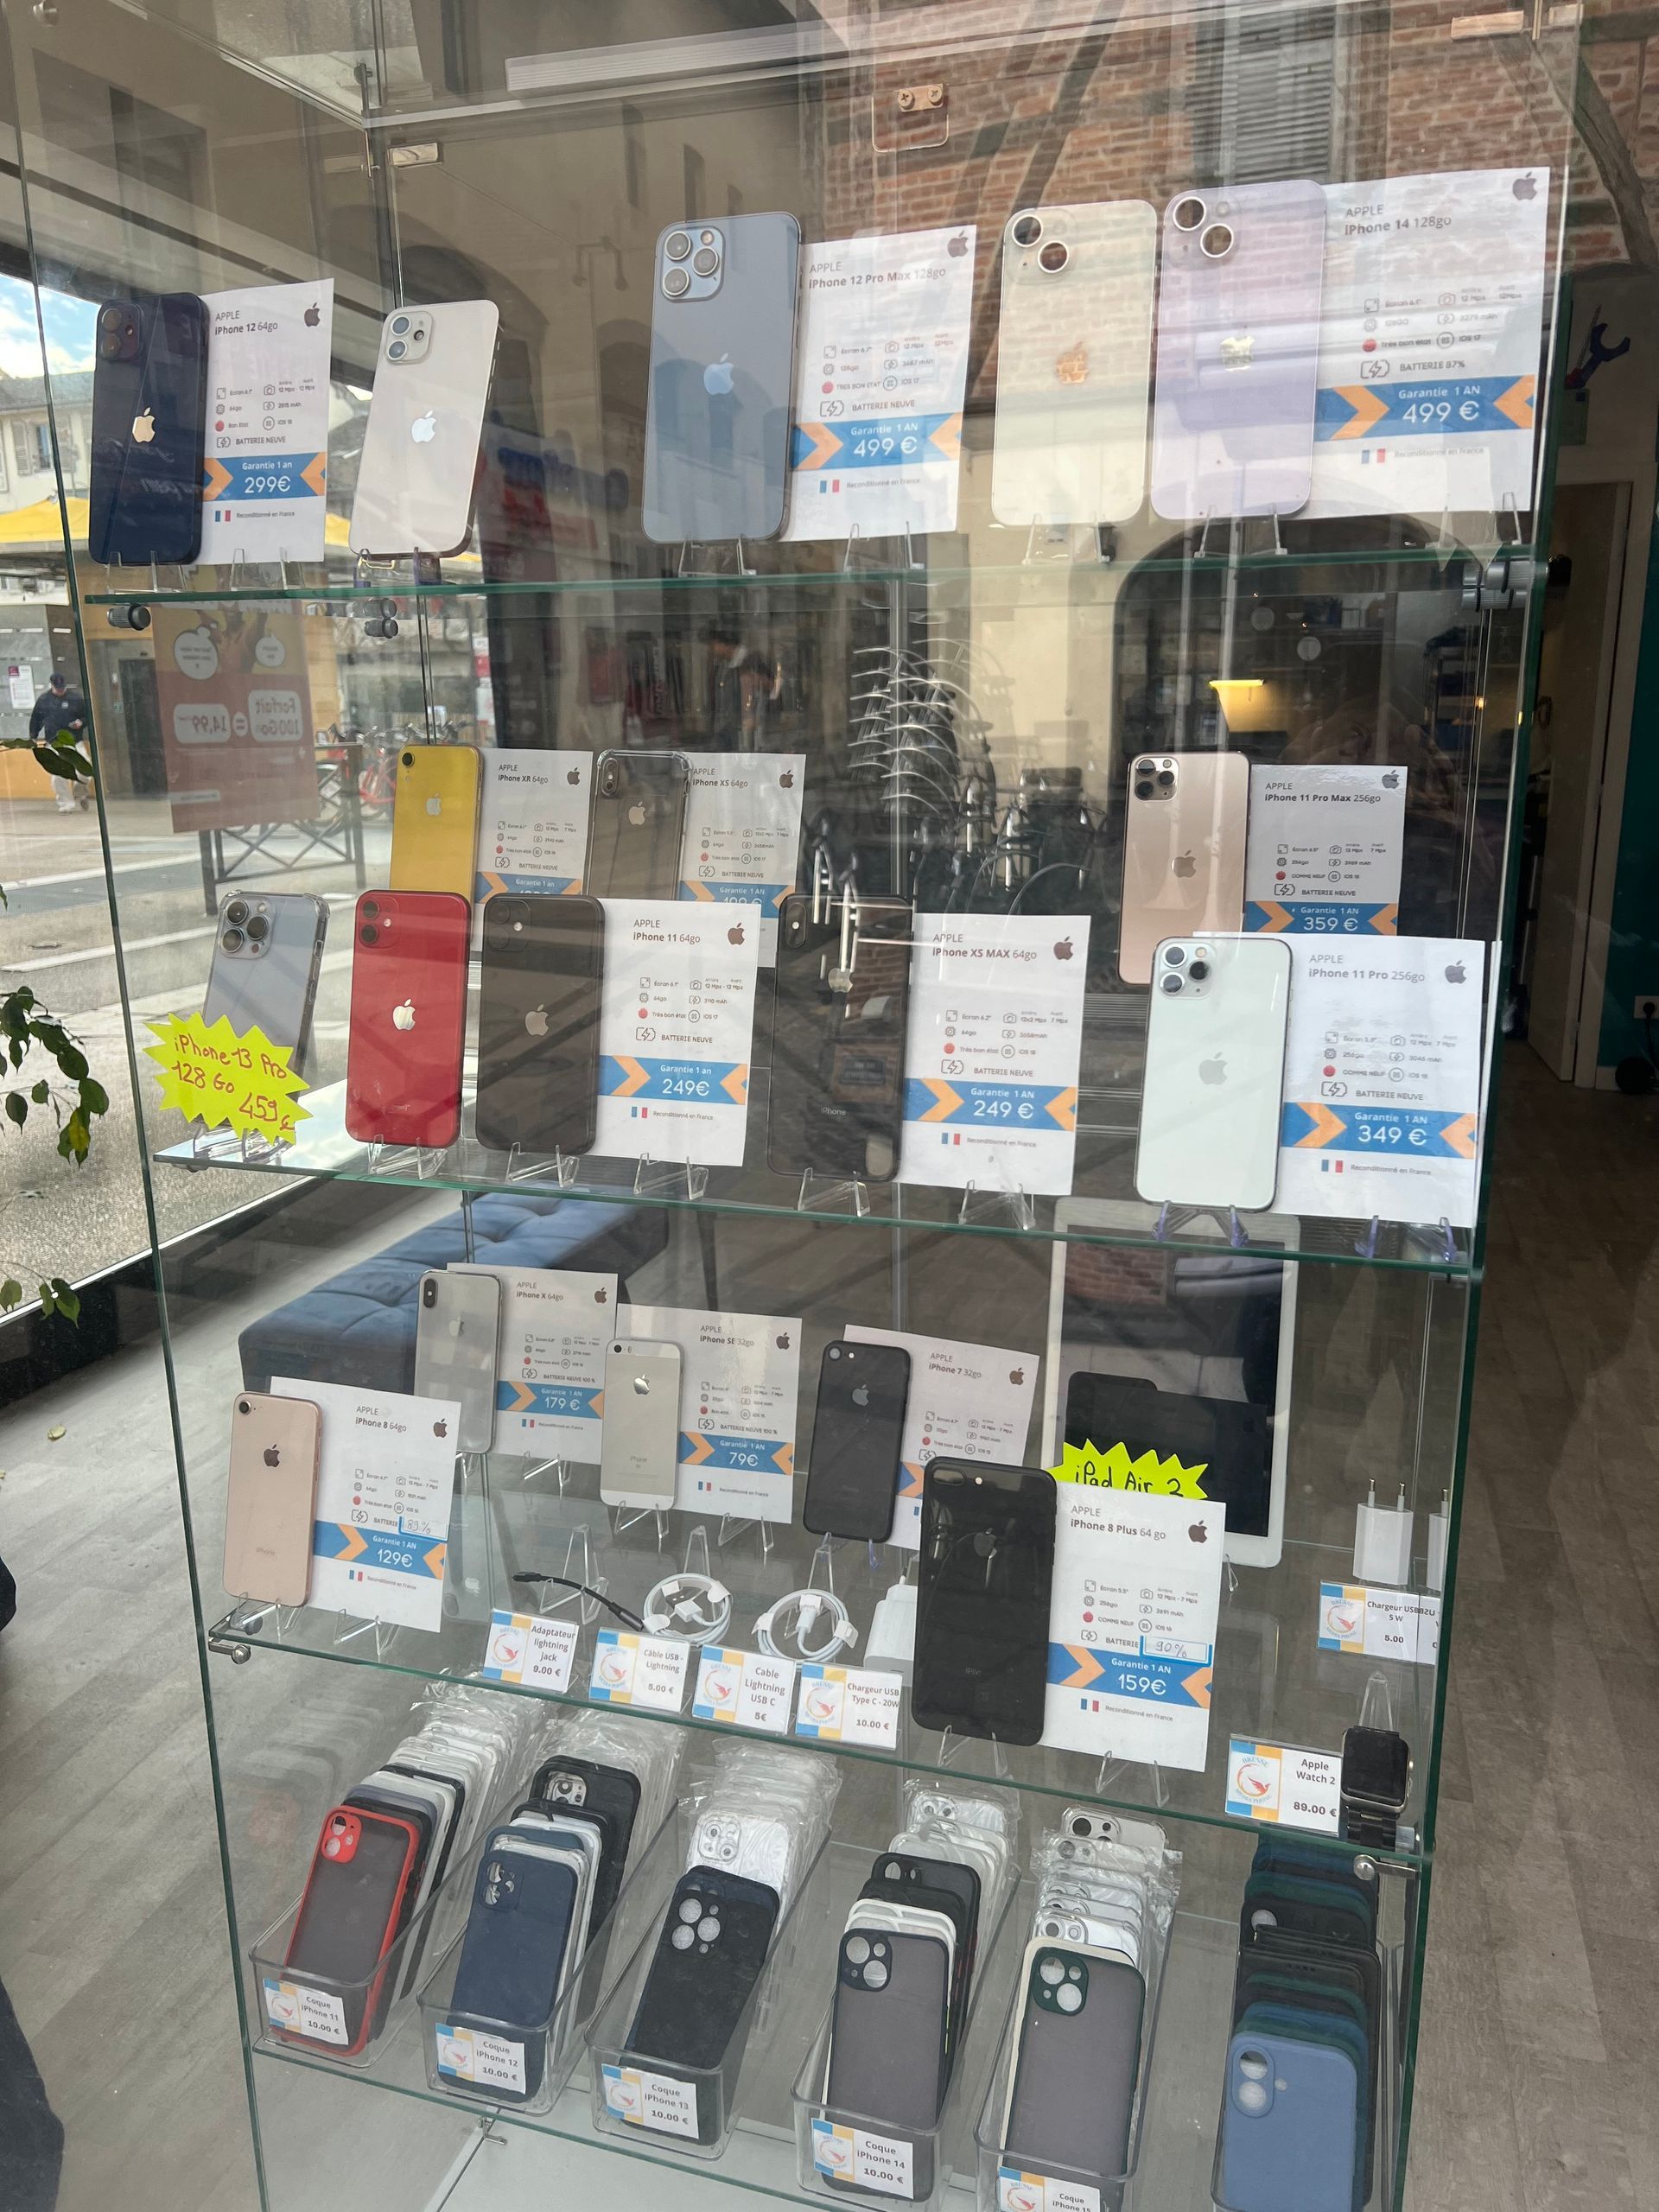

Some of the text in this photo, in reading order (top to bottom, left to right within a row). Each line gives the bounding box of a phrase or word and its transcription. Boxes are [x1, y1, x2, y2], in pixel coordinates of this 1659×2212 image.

[1345, 205, 1384, 216] APPLE
[1344, 215, 1452, 236] iPhone 14 128go
[809, 268, 945, 289] iPhone 12 Pro Max 128go
[215, 311, 240, 321] APPLE
[214, 321, 278, 335] iPhone 12 64go
[1400, 362, 1444, 372] BATTERIE
[1402, 401, 1479, 423] 499 €
[854, 435, 918, 457] 499 €
[245, 476, 291, 493] 299€
[532, 776, 548, 785] 64go
[730, 779, 748, 788] 64go
[633, 919, 660, 928] APPLE
[1303, 918, 1358, 931] 359 €
[633, 932, 664, 941] iPhone
[679, 934, 700, 944] 64go
[932, 949, 1037, 961] iPhone XS MAX 64go
[1309, 969, 1425, 982] iPhone 11 Pro 256go
[175, 1033, 287, 1078] iPhone 13 Pro
[660, 1065, 694, 1073] Garantie
[172, 1061, 234, 1093] 128 Go
[662, 1078, 709, 1096] 249€
[973, 1101, 1033, 1118] 249 €
[1358, 1125, 1427, 1146] 349 €
[737, 1338, 753, 1347] 32go
[929, 1363, 955, 1374] iPhone
[963, 1370, 981, 1379] 32go
[545, 1396, 580, 1410] 179 €
[356, 1417, 381, 1427] iPhone
[390, 1422, 407, 1432] 64go
[729, 1452, 758, 1466] 79€
[1076, 1460, 1184, 1497] iPad Air 2
[1071, 1505, 1101, 1517] APPLE
[374, 1517, 397, 1527] BATTERIE
[1071, 1519, 1166, 1540] iPhone 8 Plus 64 go
[378, 1549, 412, 1567] 129€
[1368, 1601, 1402, 1611] Chargeur
[531, 1625, 575, 1639] Adaptateur
[1105, 1637, 1140, 1649] BATTERIE
[1385, 1635, 1404, 1643] 5.00
[534, 1639, 569, 1653] lightning
[540, 1652, 556, 1662] jack
[644, 1649, 664, 1659] Câble
[665, 1652, 679, 1661] USB
[533, 1665, 553, 1675] 9.00
[646, 1661, 680, 1673] Lightning
[755, 1668, 779, 1679] Cable
[648, 1683, 666, 1693] 5.00
[745, 1680, 785, 1695] Lightning
[848, 1683, 899, 1696] Chargeur USB
[1118, 1674, 1166, 1695] 159€
[751, 1694, 767, 1704] USB
[852, 1694, 870, 1705] Type
[754, 1713, 766, 1721] 5€
[856, 1719, 880, 1728] 10.00
[1301, 1758, 1329, 1771] Apple
[1296, 1770, 1326, 1783] Watch
[1294, 1802, 1337, 1817] 89.00 €
[306, 1996, 331, 2009] Coque
[302, 2005, 328, 2018] iPhone
[483, 2041, 510, 2054] Coque
[476, 2050, 518, 2067] iPhone 12
[482, 2066, 509, 2079] 10.00
[652, 2083, 681, 2097] Coque
[645, 2094, 676, 2107] iPhone
[865, 2140, 896, 2155] Coque
[857, 2150, 906, 2169] iPhone 14
[1059, 2193, 1084, 2203] Coque
[1052, 2201, 1080, 2212] iPhone
